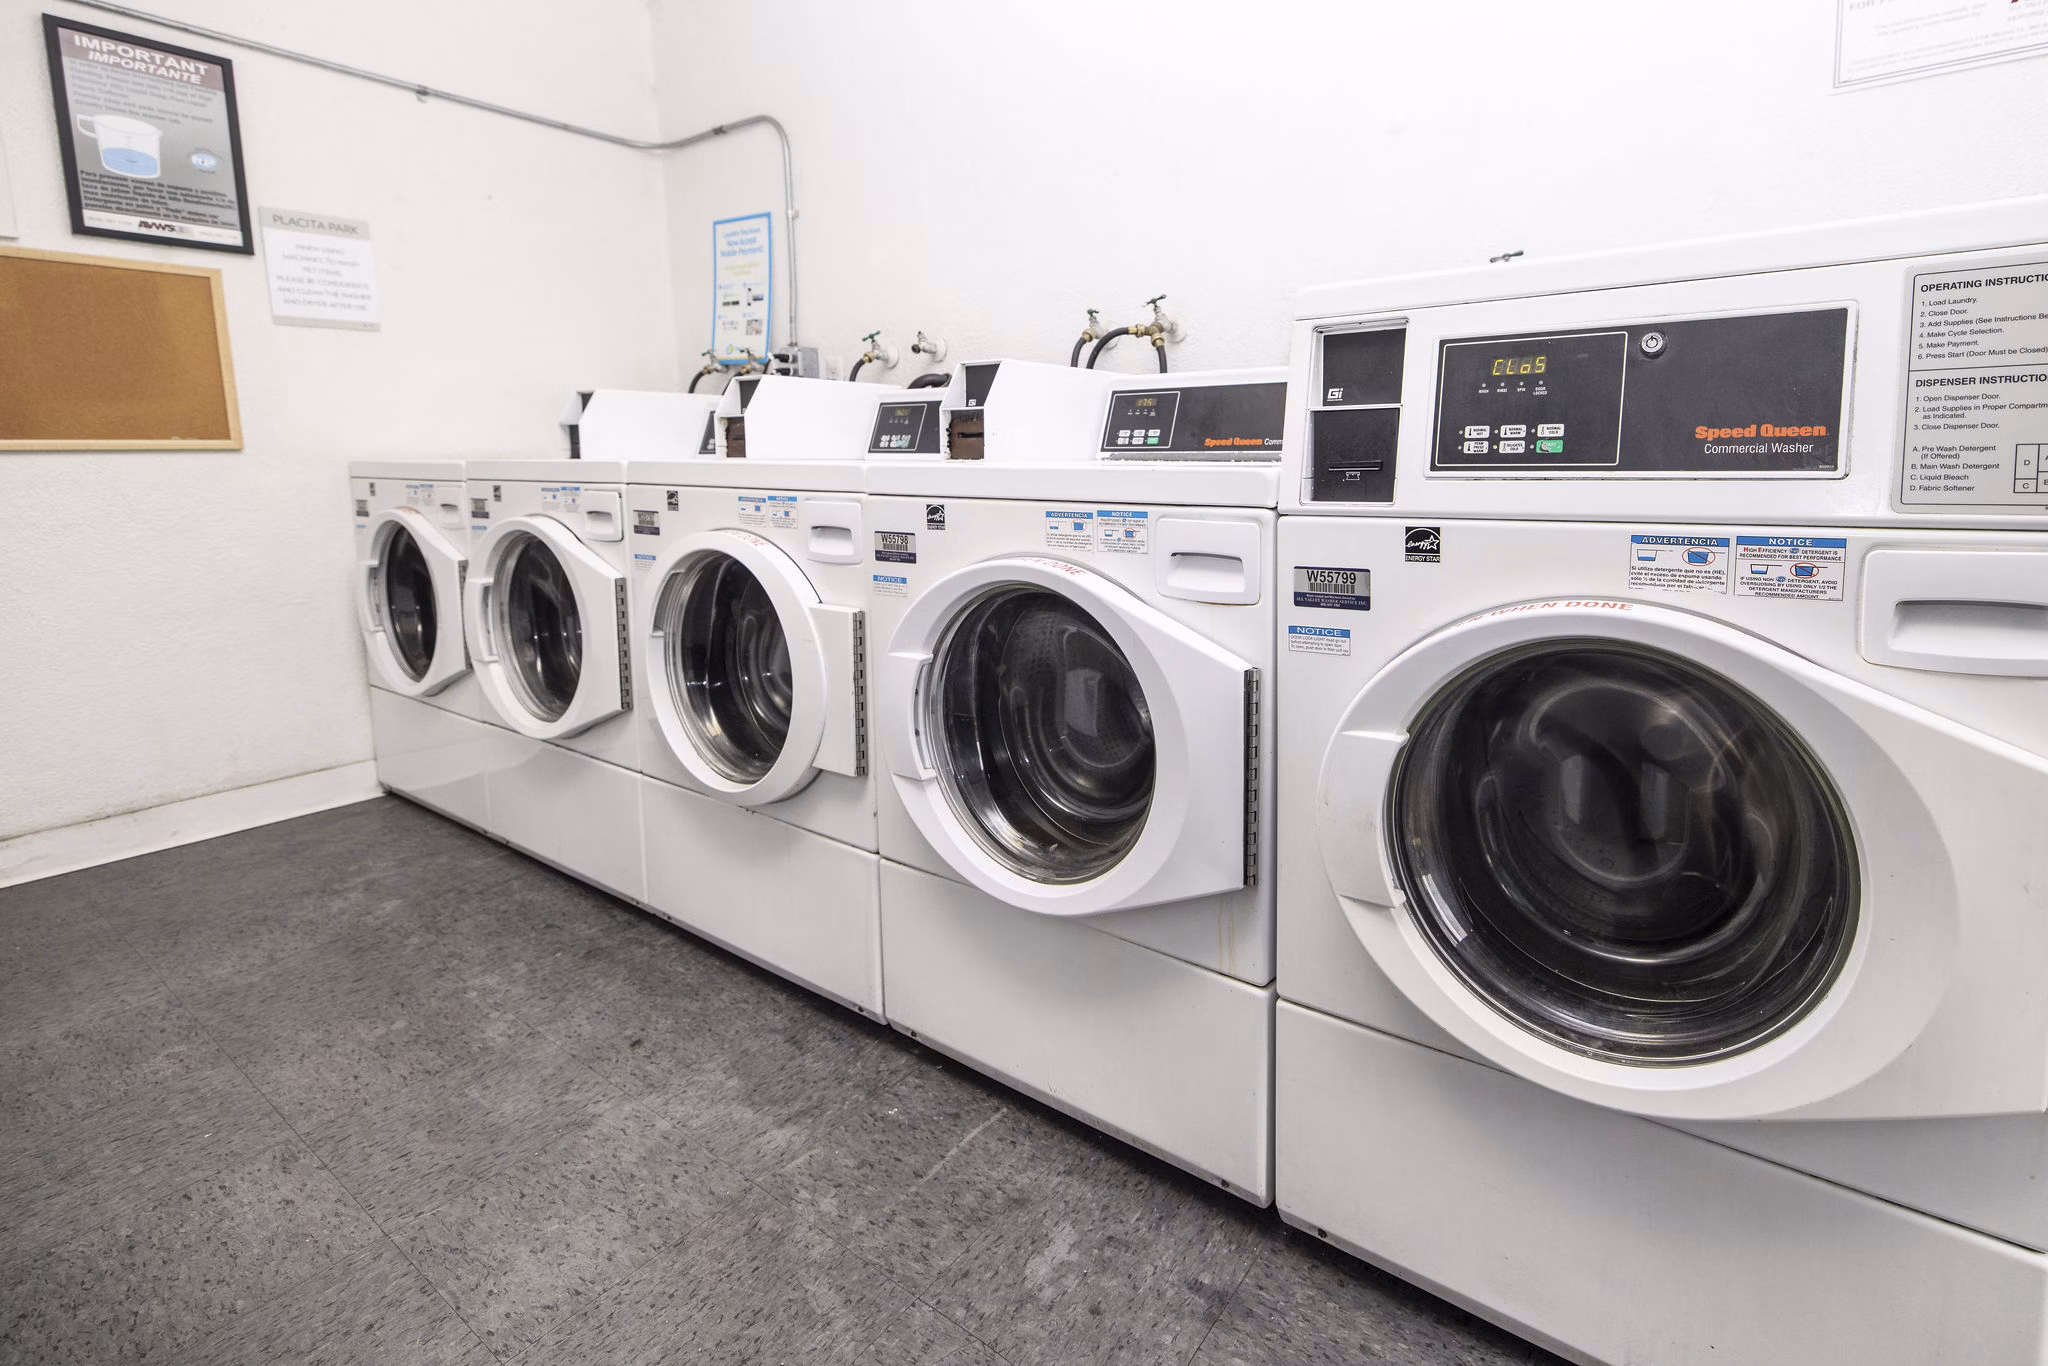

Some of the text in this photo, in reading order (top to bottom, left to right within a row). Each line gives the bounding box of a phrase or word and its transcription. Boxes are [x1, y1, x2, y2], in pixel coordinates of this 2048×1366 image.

[74, 35, 208, 75] IMPORTANT
[88, 51, 202, 84] IMPORTANTE
[272, 214, 360, 235] PLACITA PARK
[1921, 280, 1982, 292] OPERATING
[1944, 318, 1974, 327] Supplies
[1975, 317, 1992, 325] (See
[1994, 314, 2036, 323] Instructions
[1948, 329, 1967, 338] Cycle
[1969, 327, 2004, 335] Selection.
[1947, 340, 1979, 348] Payment.
[1966, 350, 1986, 358] (Door
[1916, 377, 1976, 387] DISPENSER
[1944, 394, 1979, 402] Dispenser
[1942, 404, 1972, 412] Supplies
[1982, 403, 2007, 411] Proper
[1943, 423, 1978, 431] Dispenser
[1695, 424, 1827, 441] Speed Queen
[1204, 438, 1232, 447] Speed
[1234, 437, 1262, 445] Queen
[1704, 443, 1814, 454] Commercial Washer
[1962, 463, 2000, 471] Detergent
[1642, 537, 1718, 546] ADVERTENCIA
[1307, 570, 1356, 584] W55799
[1490, 601, 1634, 616] WHEN DONE
[1297, 626, 1342, 636] NOTICE
